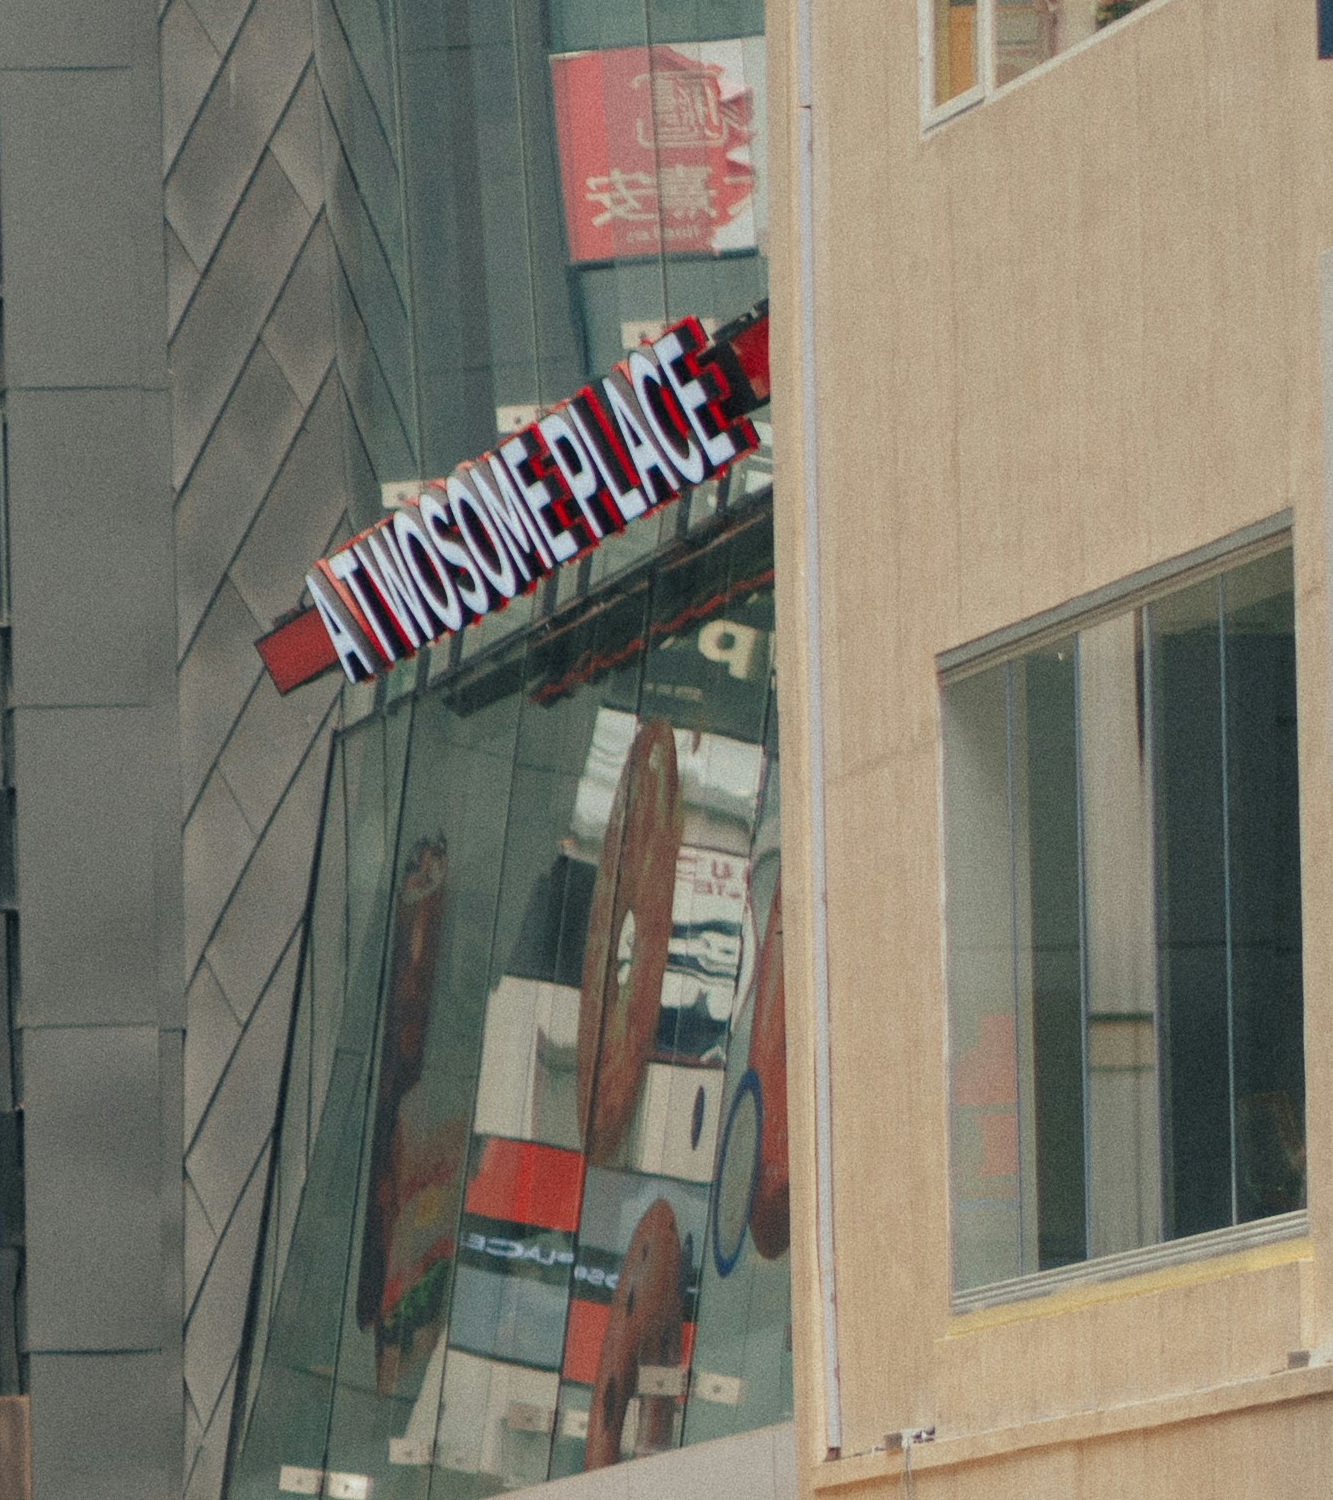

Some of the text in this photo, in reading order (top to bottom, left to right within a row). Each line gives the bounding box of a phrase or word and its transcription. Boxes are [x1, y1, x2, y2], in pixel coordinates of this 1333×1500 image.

[305, 332, 735, 683] A TWOSOME PLACE
